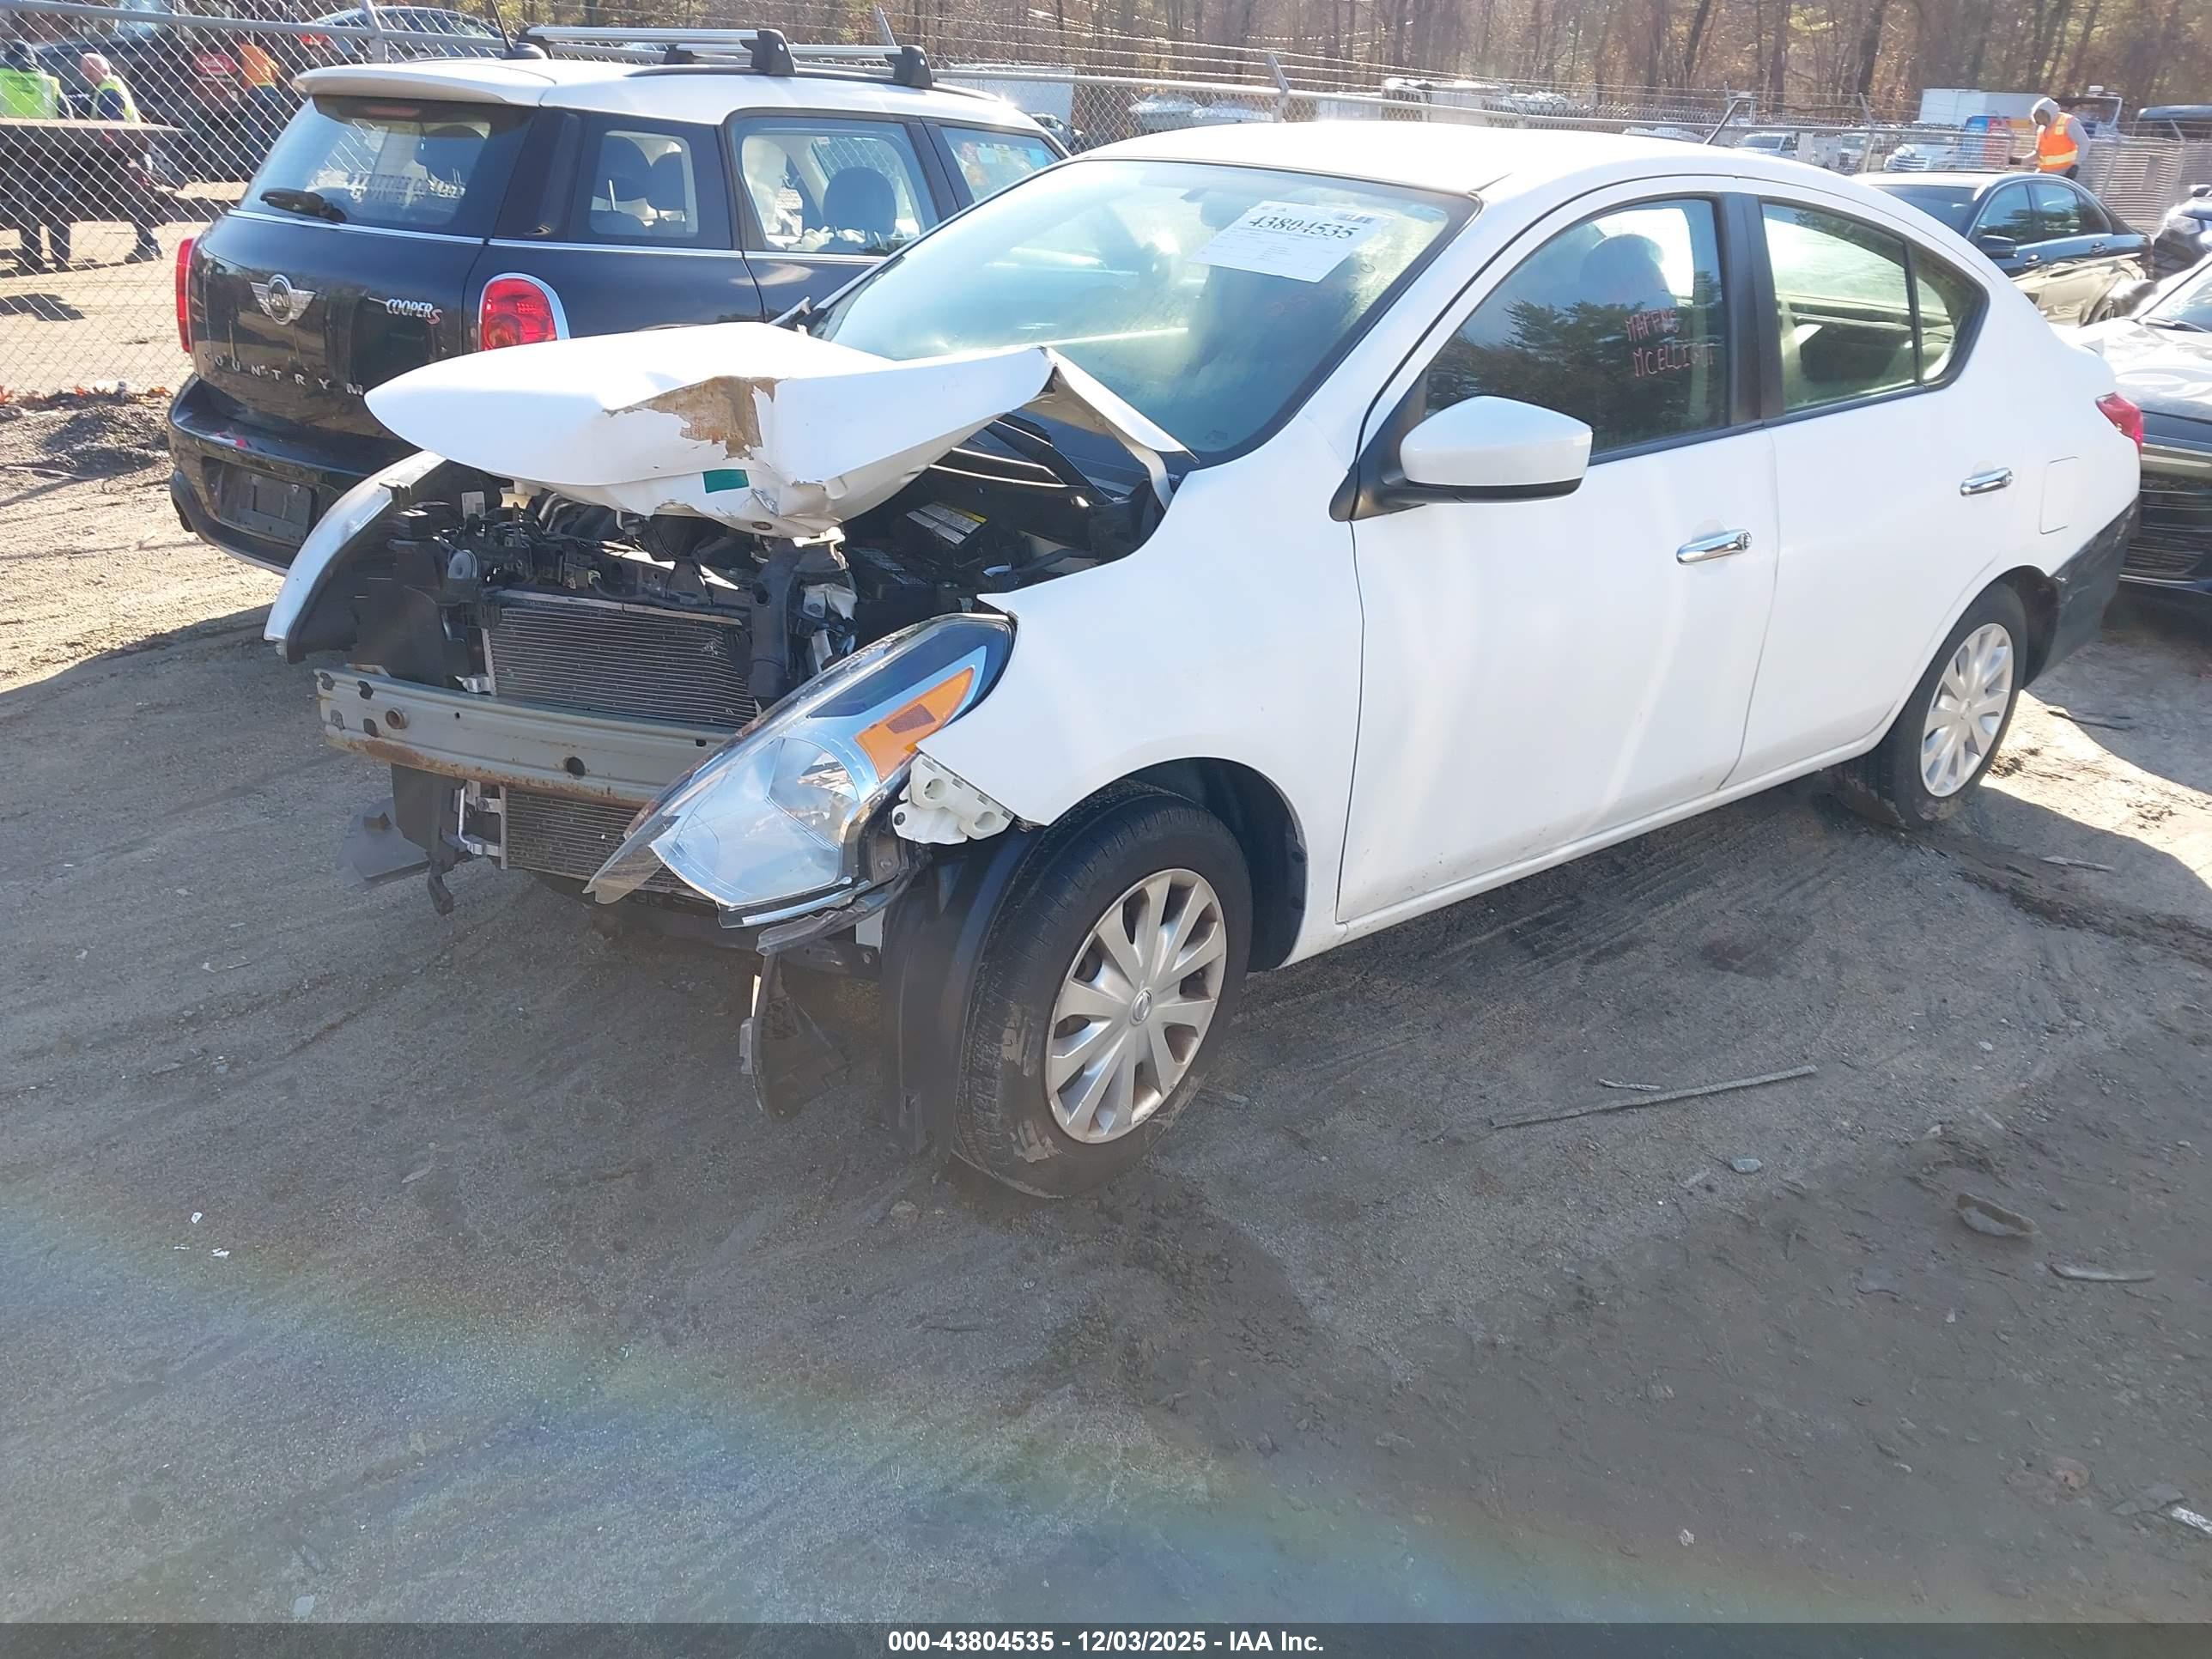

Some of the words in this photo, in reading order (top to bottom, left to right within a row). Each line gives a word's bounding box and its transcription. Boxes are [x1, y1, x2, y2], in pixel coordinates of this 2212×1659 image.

[1248, 215, 1361, 240] 43804535
[386, 298, 434, 319] COOPER
[204, 350, 364, 396] COUNTRYM
